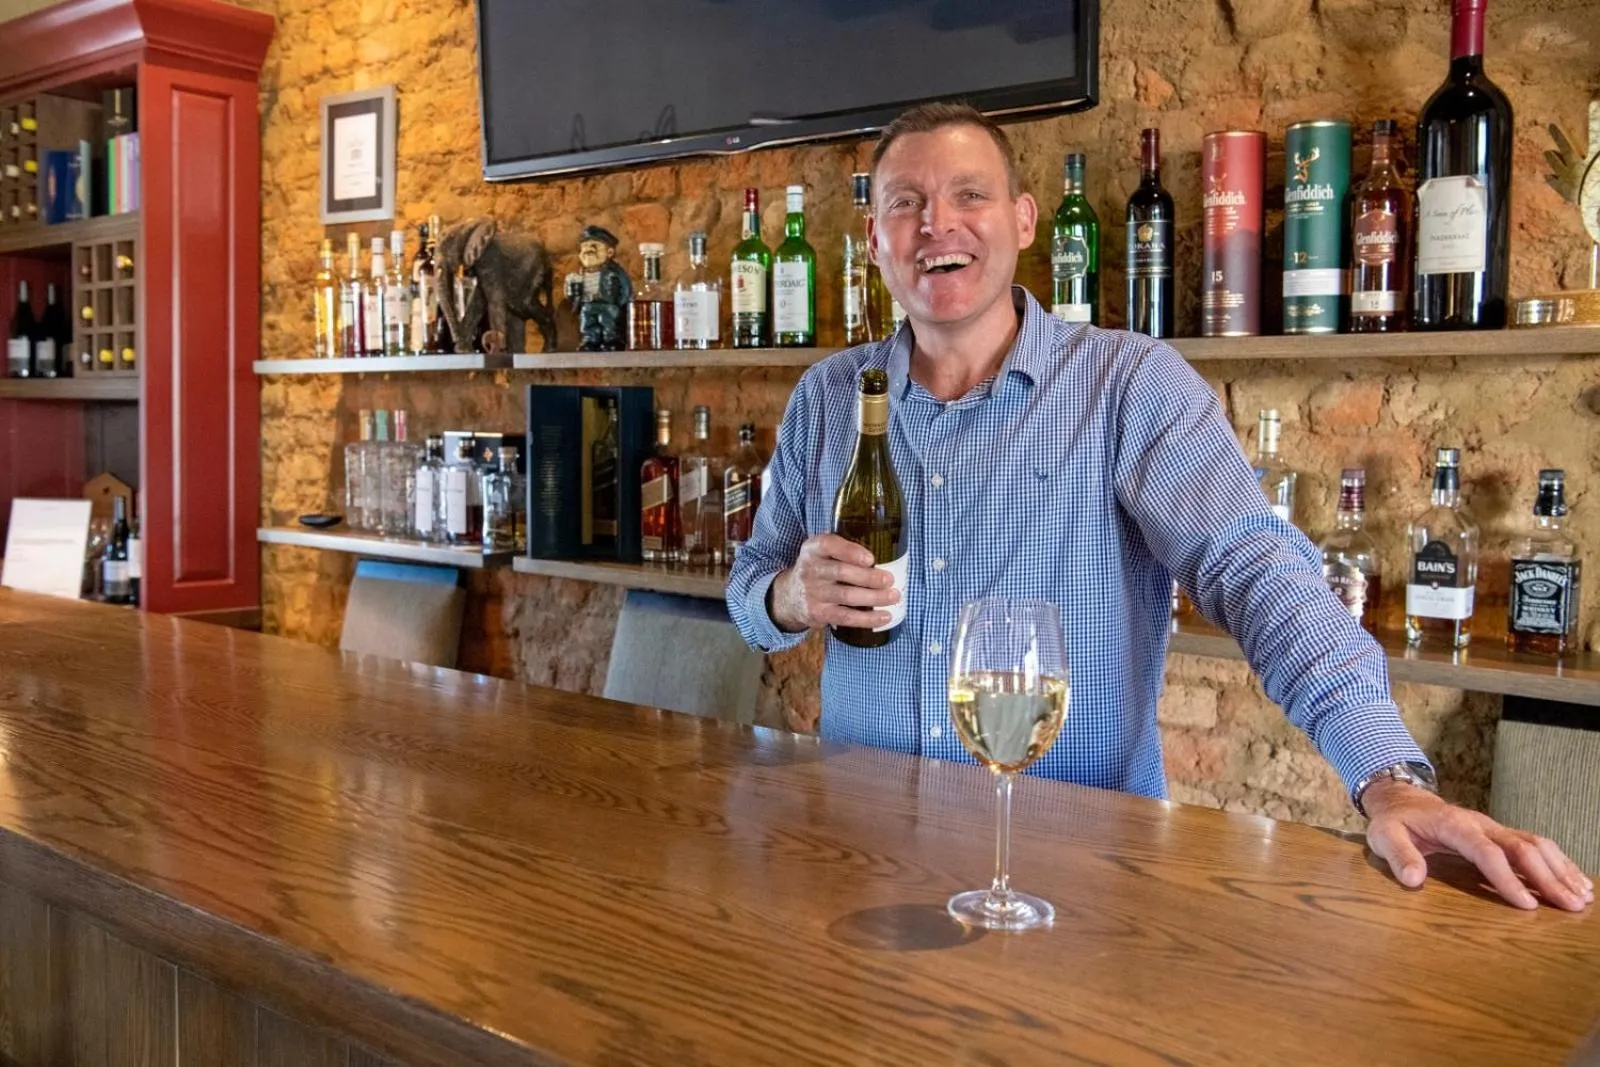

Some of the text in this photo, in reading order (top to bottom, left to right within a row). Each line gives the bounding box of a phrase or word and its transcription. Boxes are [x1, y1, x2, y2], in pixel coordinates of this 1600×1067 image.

[1293, 252, 1308, 264] 12
[1211, 271, 1223, 283] 15
[1417, 561, 1456, 574] BAIN'S
[1515, 569, 1536, 584] JACK
